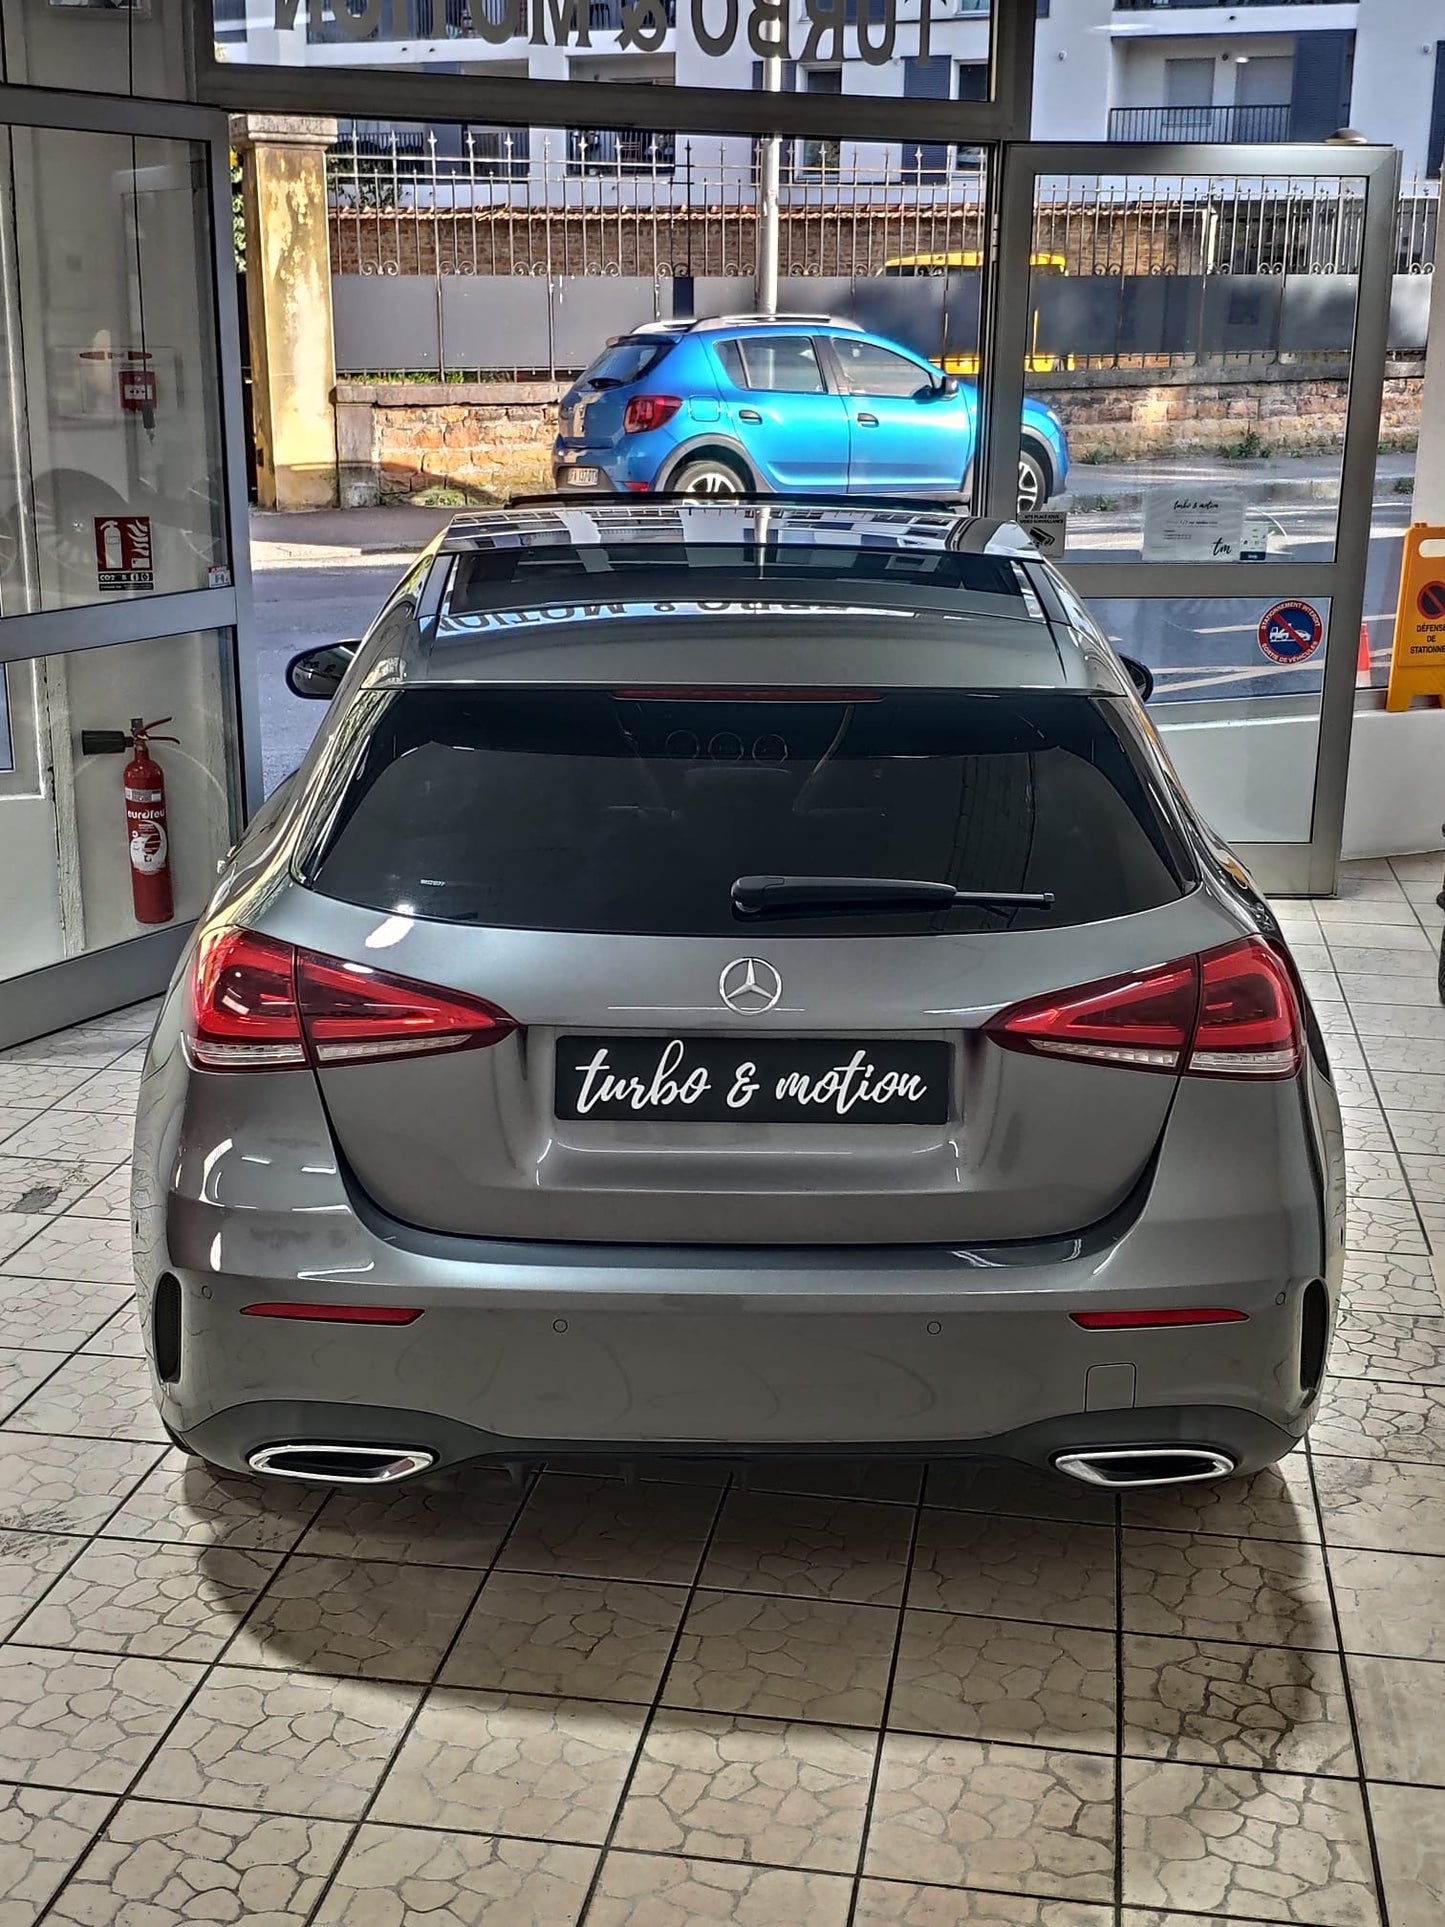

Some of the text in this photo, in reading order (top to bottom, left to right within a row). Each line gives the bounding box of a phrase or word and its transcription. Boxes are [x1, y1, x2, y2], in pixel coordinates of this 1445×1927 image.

[1261, 602, 1320, 630] STATIONNEMENT INTERDIT
[1262, 643, 1279, 660] SORTIE
[575, 1039, 928, 1115] turbo & motion
